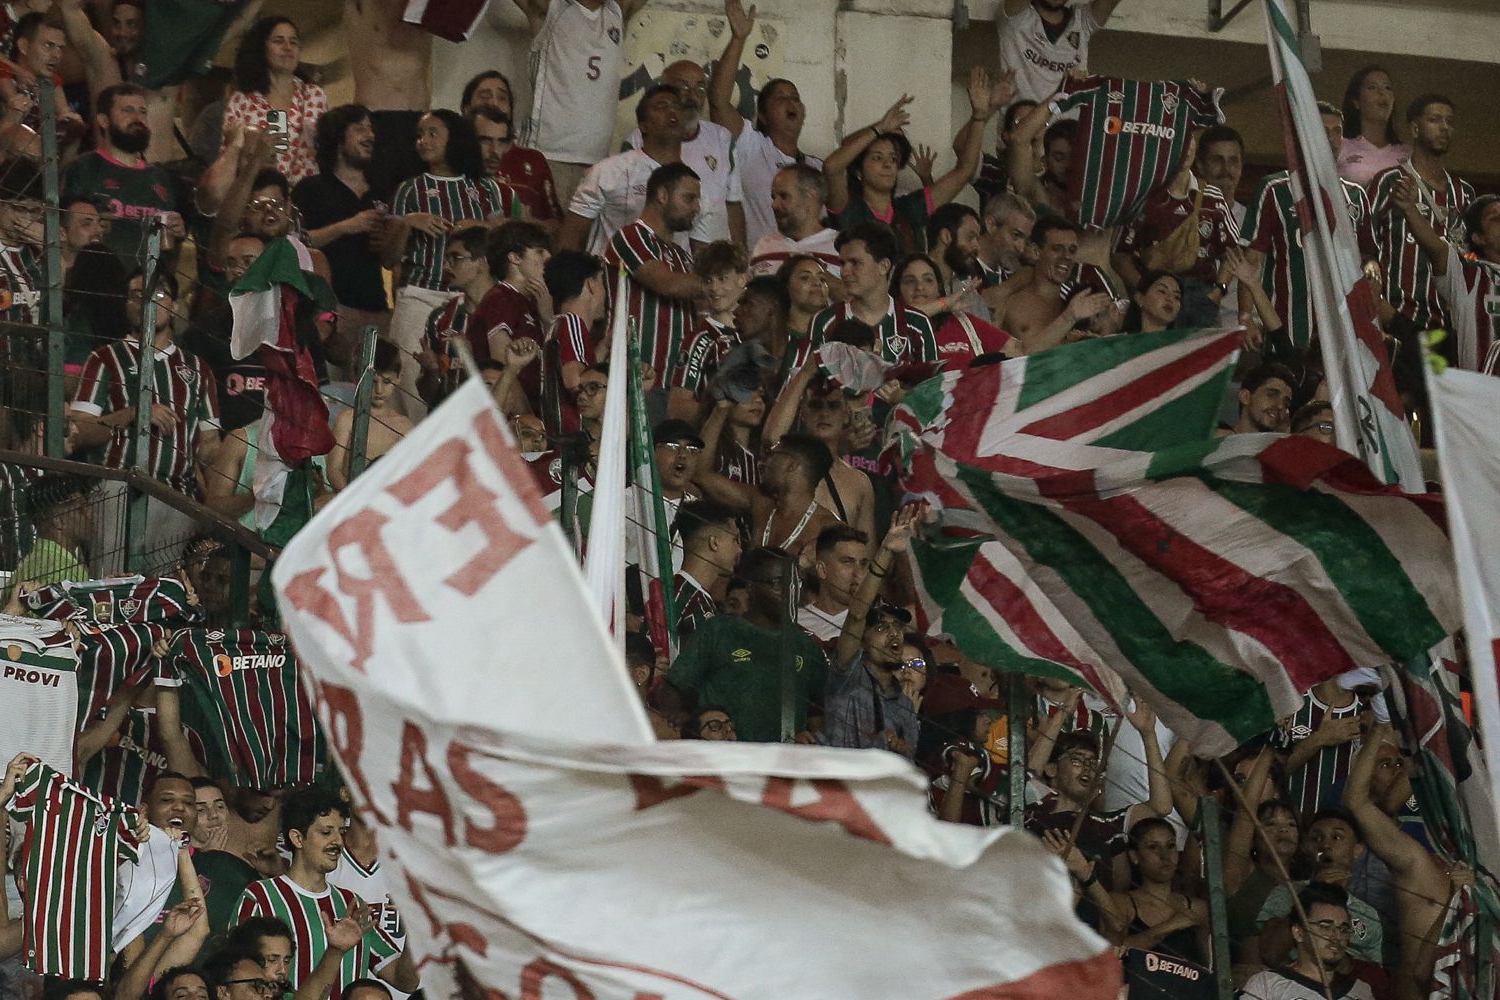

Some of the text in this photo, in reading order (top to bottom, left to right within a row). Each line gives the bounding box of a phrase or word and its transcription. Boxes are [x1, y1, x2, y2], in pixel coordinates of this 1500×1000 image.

[1121, 120, 1175, 140] BETANO
[232, 654, 286, 671] BETANO
[3, 665, 61, 688] PROVI
[1159, 961, 1200, 982] BETANO
